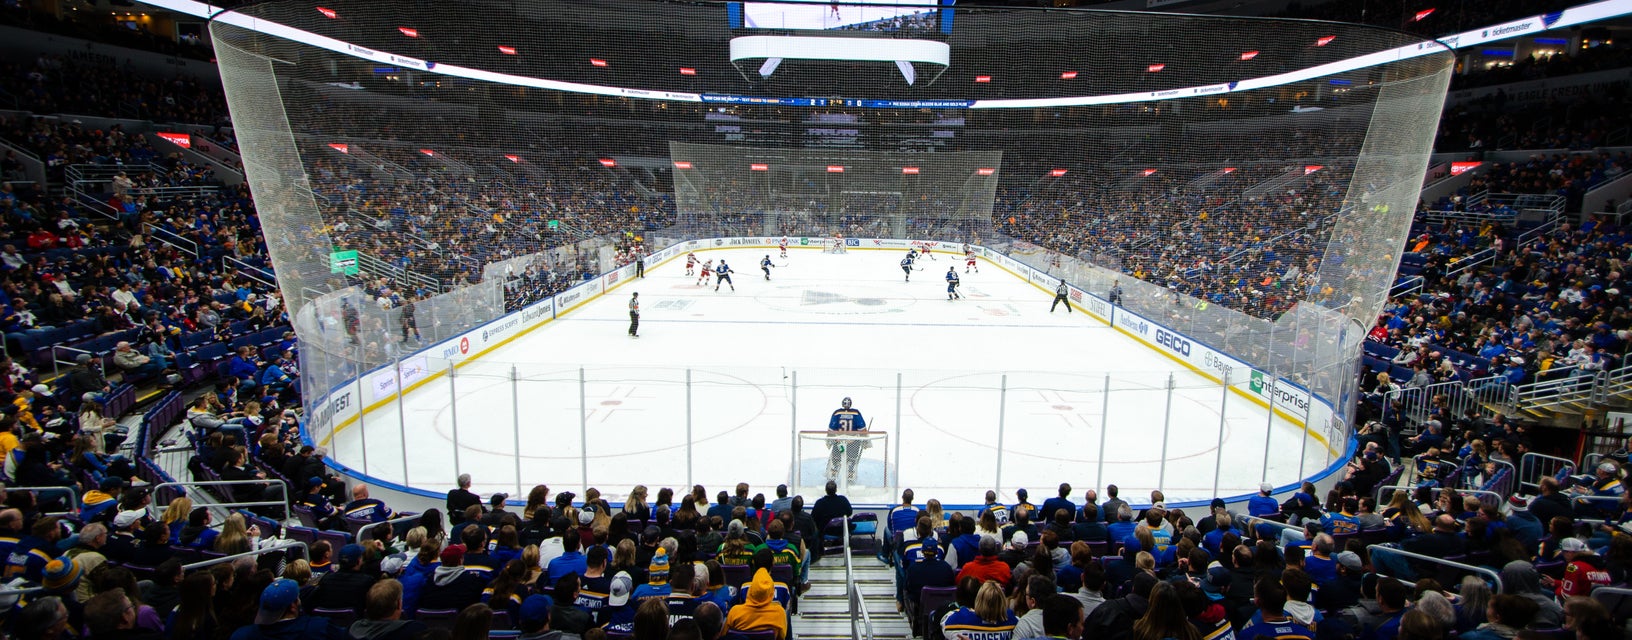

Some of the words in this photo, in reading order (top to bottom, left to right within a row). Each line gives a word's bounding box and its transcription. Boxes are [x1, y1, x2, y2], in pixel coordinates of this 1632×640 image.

[1492, 23, 1532, 37] ticketmaster
[488, 325, 505, 337] EXPRESS
[1155, 328, 1191, 357] GEICO
[443, 345, 459, 360] BMO
[403, 366, 417, 380] Sprint
[1213, 356, 1233, 376] Bayer
[380, 377, 394, 391] Sprint
[1253, 375, 1310, 412] enterprise
[839, 419, 853, 432] 31
[962, 632, 1012, 640] ARASENK
